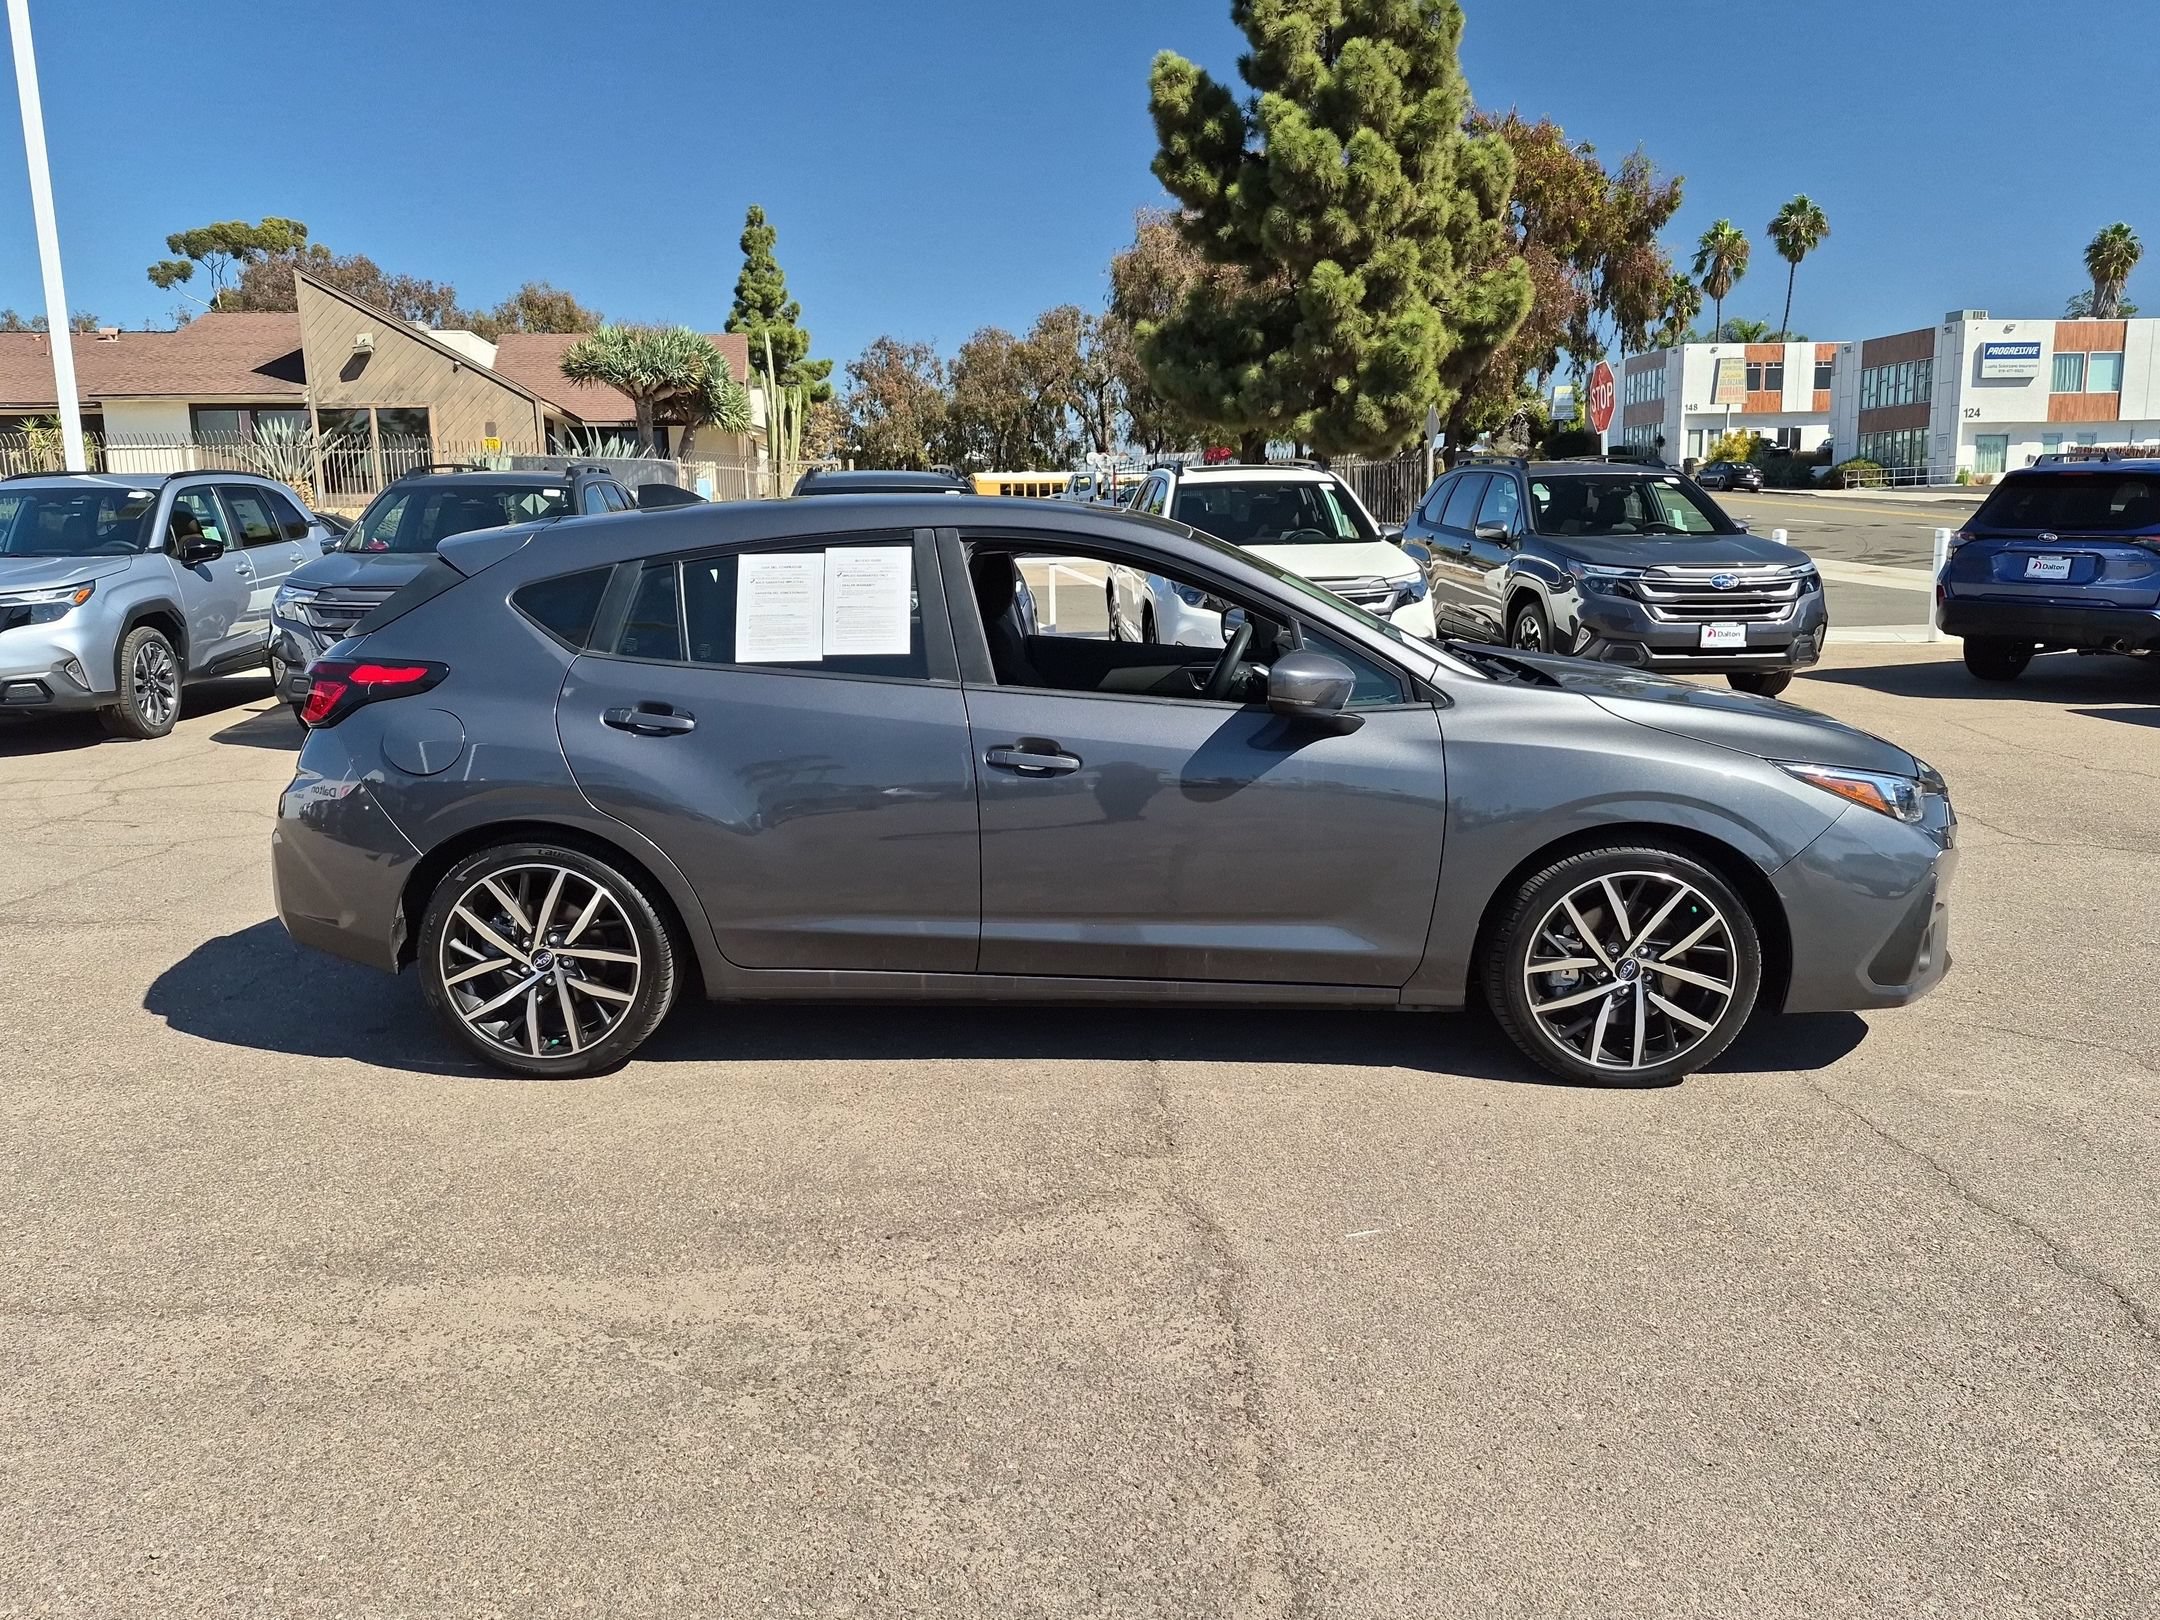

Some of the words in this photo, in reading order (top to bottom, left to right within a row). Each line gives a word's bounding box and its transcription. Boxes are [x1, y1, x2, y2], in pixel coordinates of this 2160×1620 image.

[1986, 346, 2039, 355] PROGRESSIVE
[1591, 382, 1613, 412] STOP
[1963, 408, 1981, 418] 124
